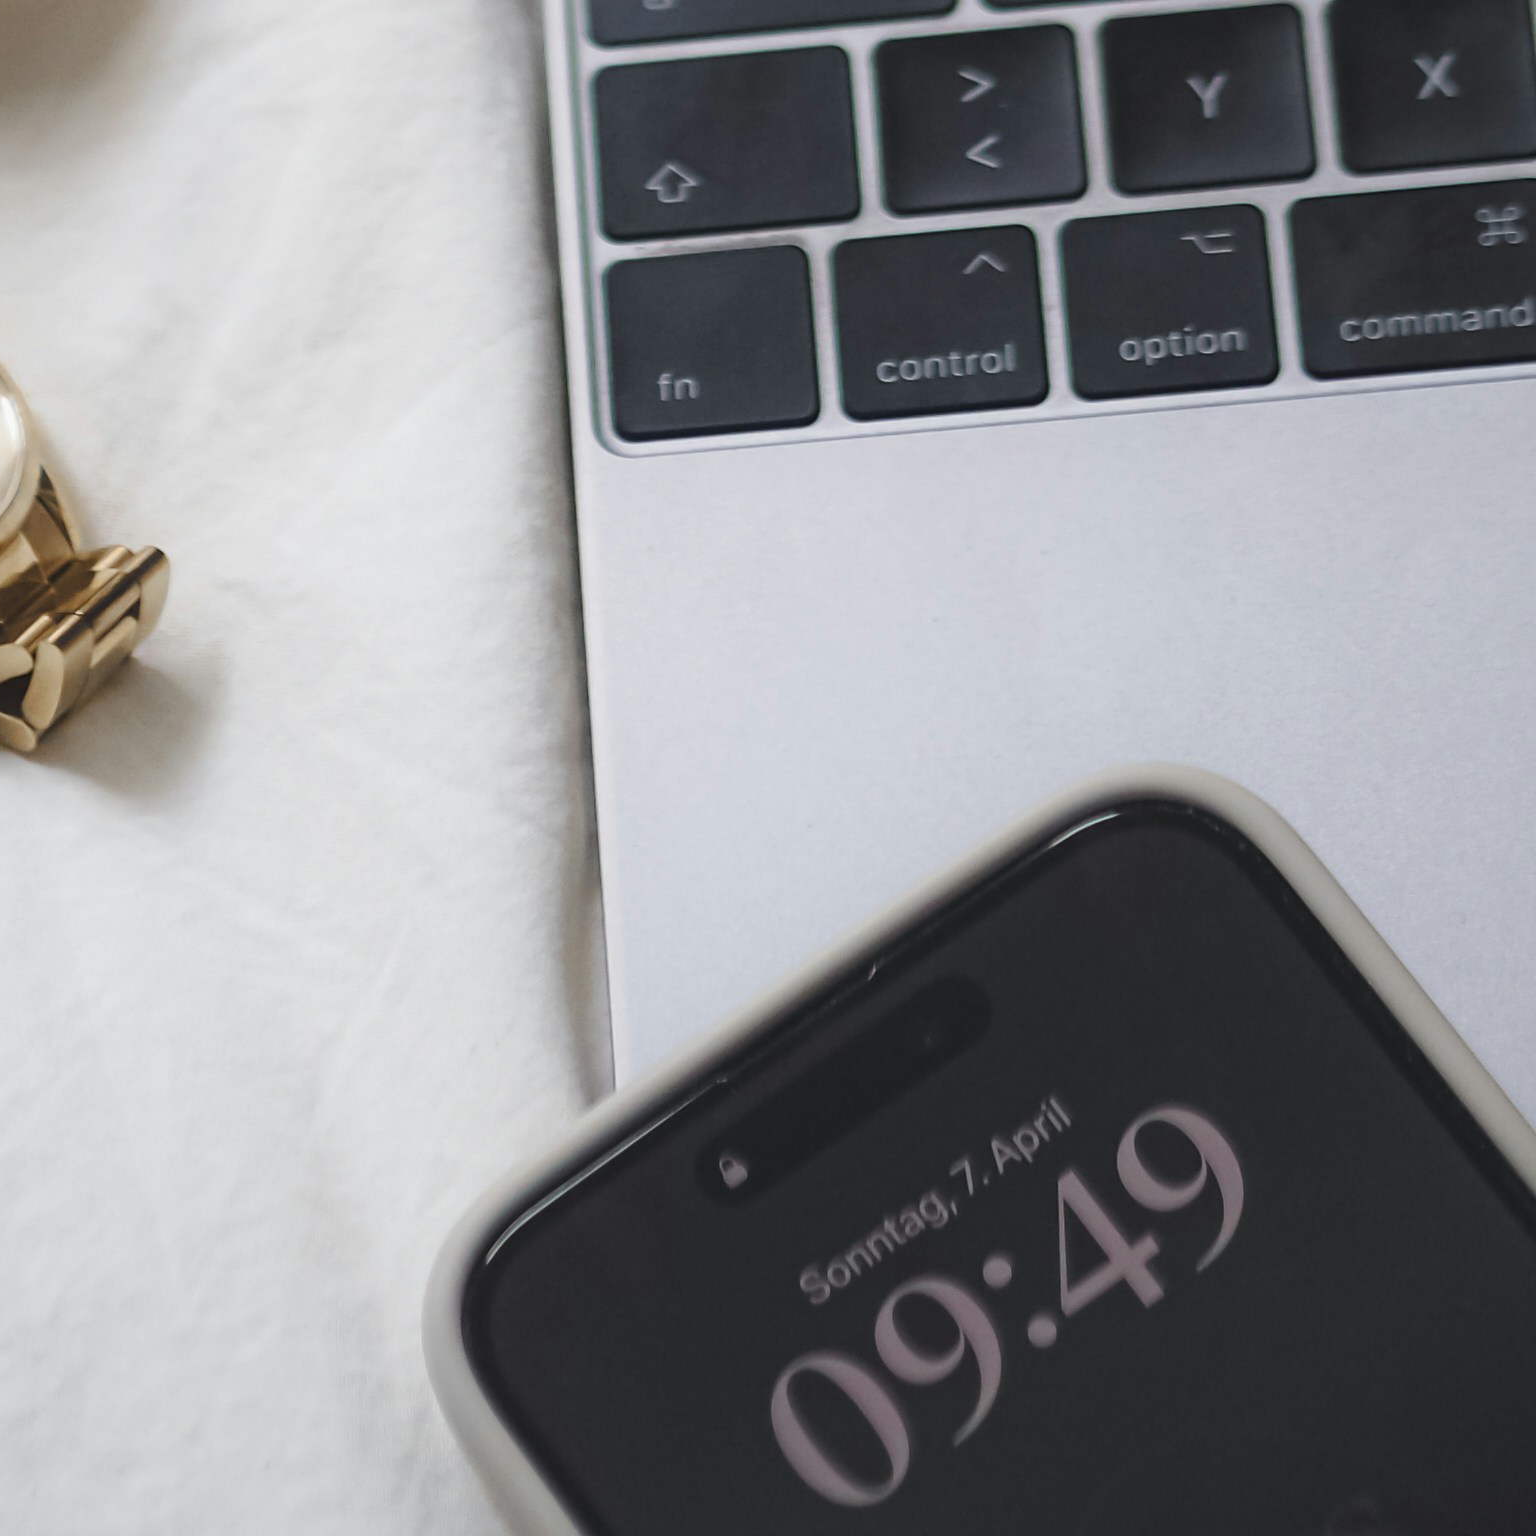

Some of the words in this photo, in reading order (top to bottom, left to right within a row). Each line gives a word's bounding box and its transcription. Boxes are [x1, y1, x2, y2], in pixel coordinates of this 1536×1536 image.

[1185, 71, 1230, 120] Y
[1414, 51, 1460, 102] X
[1338, 294, 1536, 343] command
[875, 342, 1019, 387] control
[1117, 323, 1250, 368] option
[656, 371, 700, 405] fn
[798, 1190, 958, 1305] Sonntag,
[948, 1154, 990, 1197] 7.
[990, 1094, 1072, 1176] April
[770, 1104, 1246, 1509] 09:49
